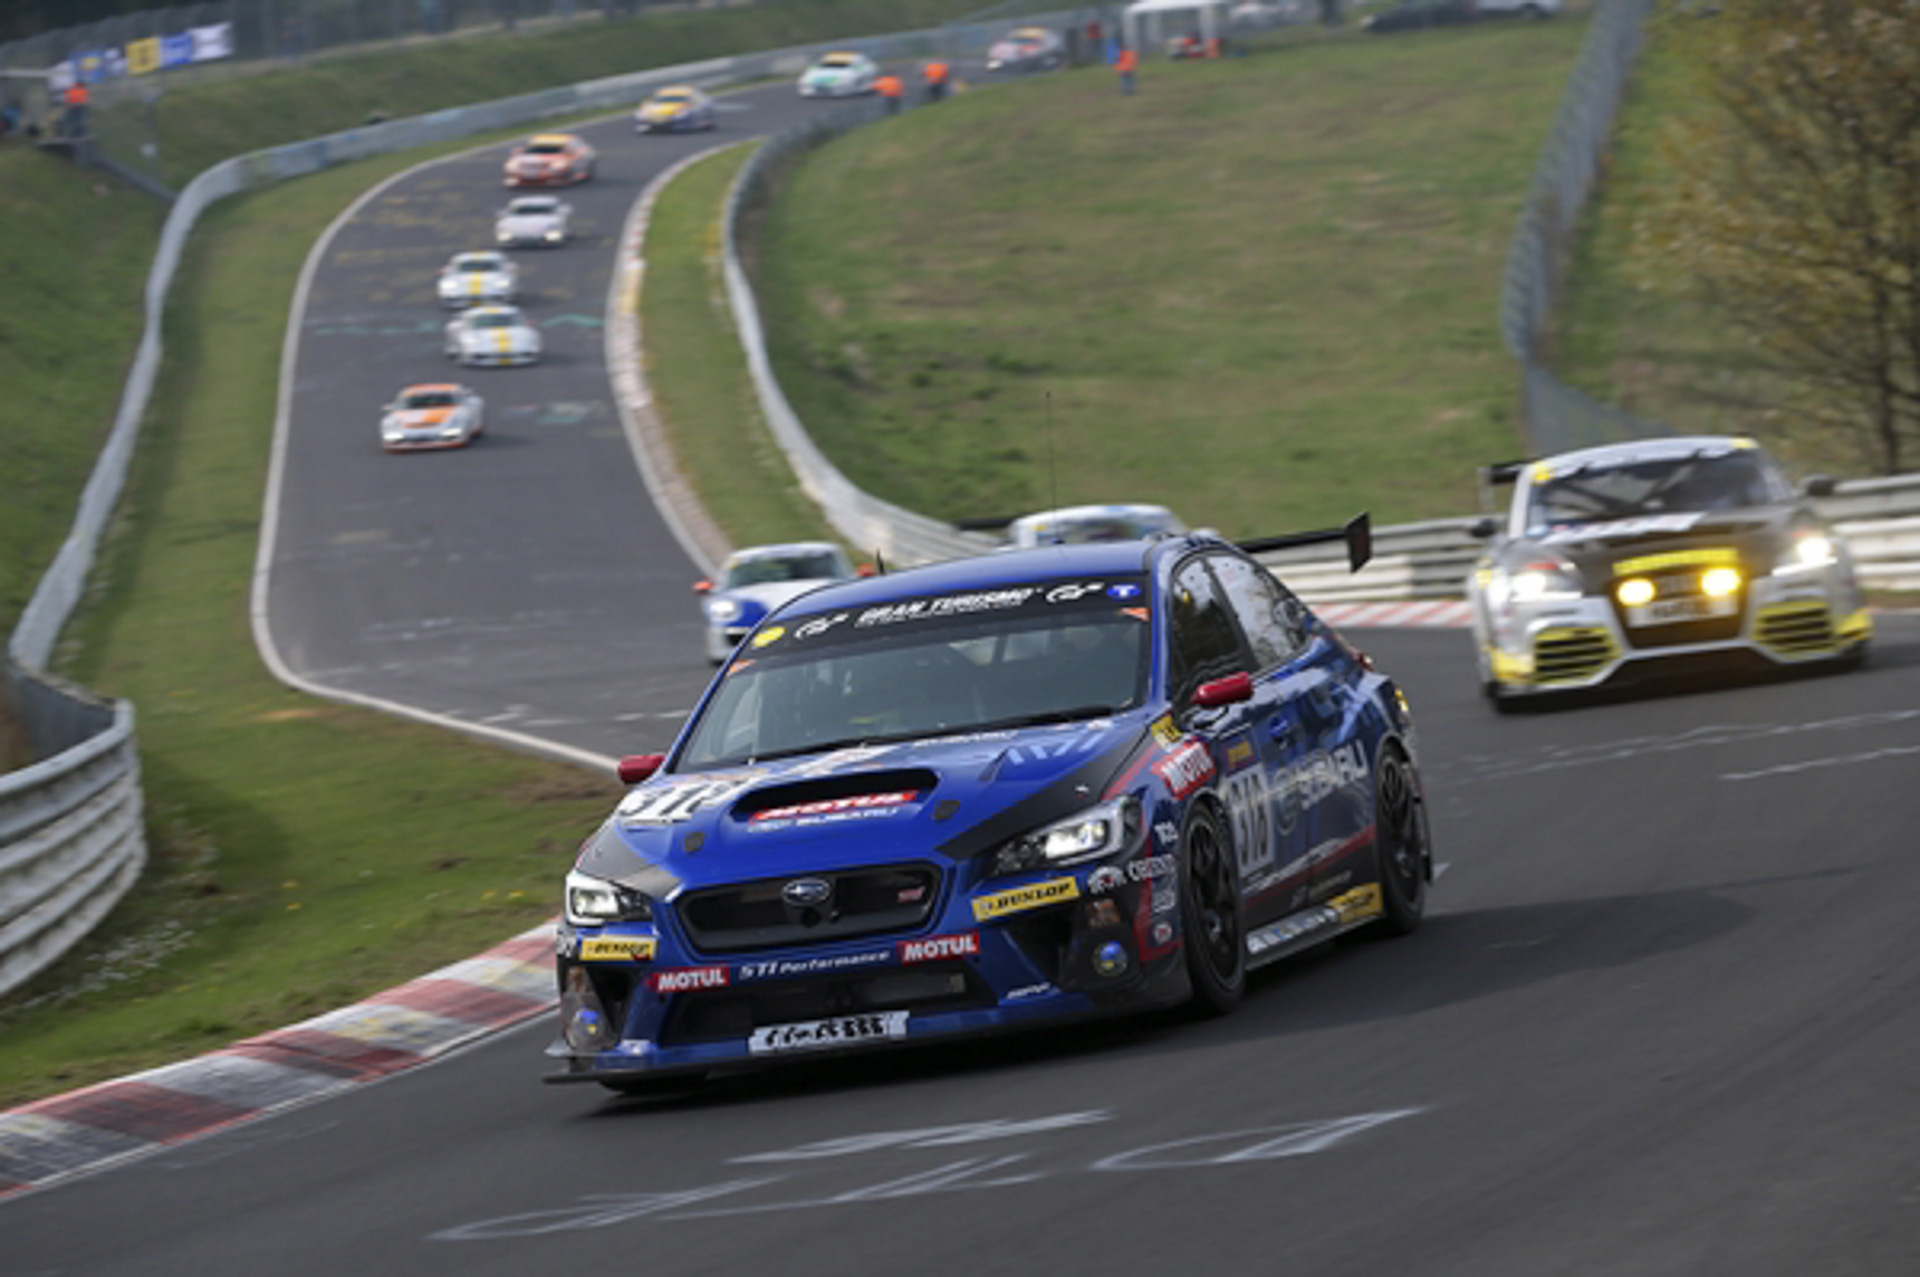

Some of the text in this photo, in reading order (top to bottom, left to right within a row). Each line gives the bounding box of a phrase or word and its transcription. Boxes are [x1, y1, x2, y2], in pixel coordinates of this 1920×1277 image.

[930, 587, 1034, 612] TURISMO
[997, 882, 1072, 911] DUNLOP
[903, 936, 978, 962] MOTUL
[739, 951, 891, 982] STI Performance
[658, 969, 728, 991] MOTUL
